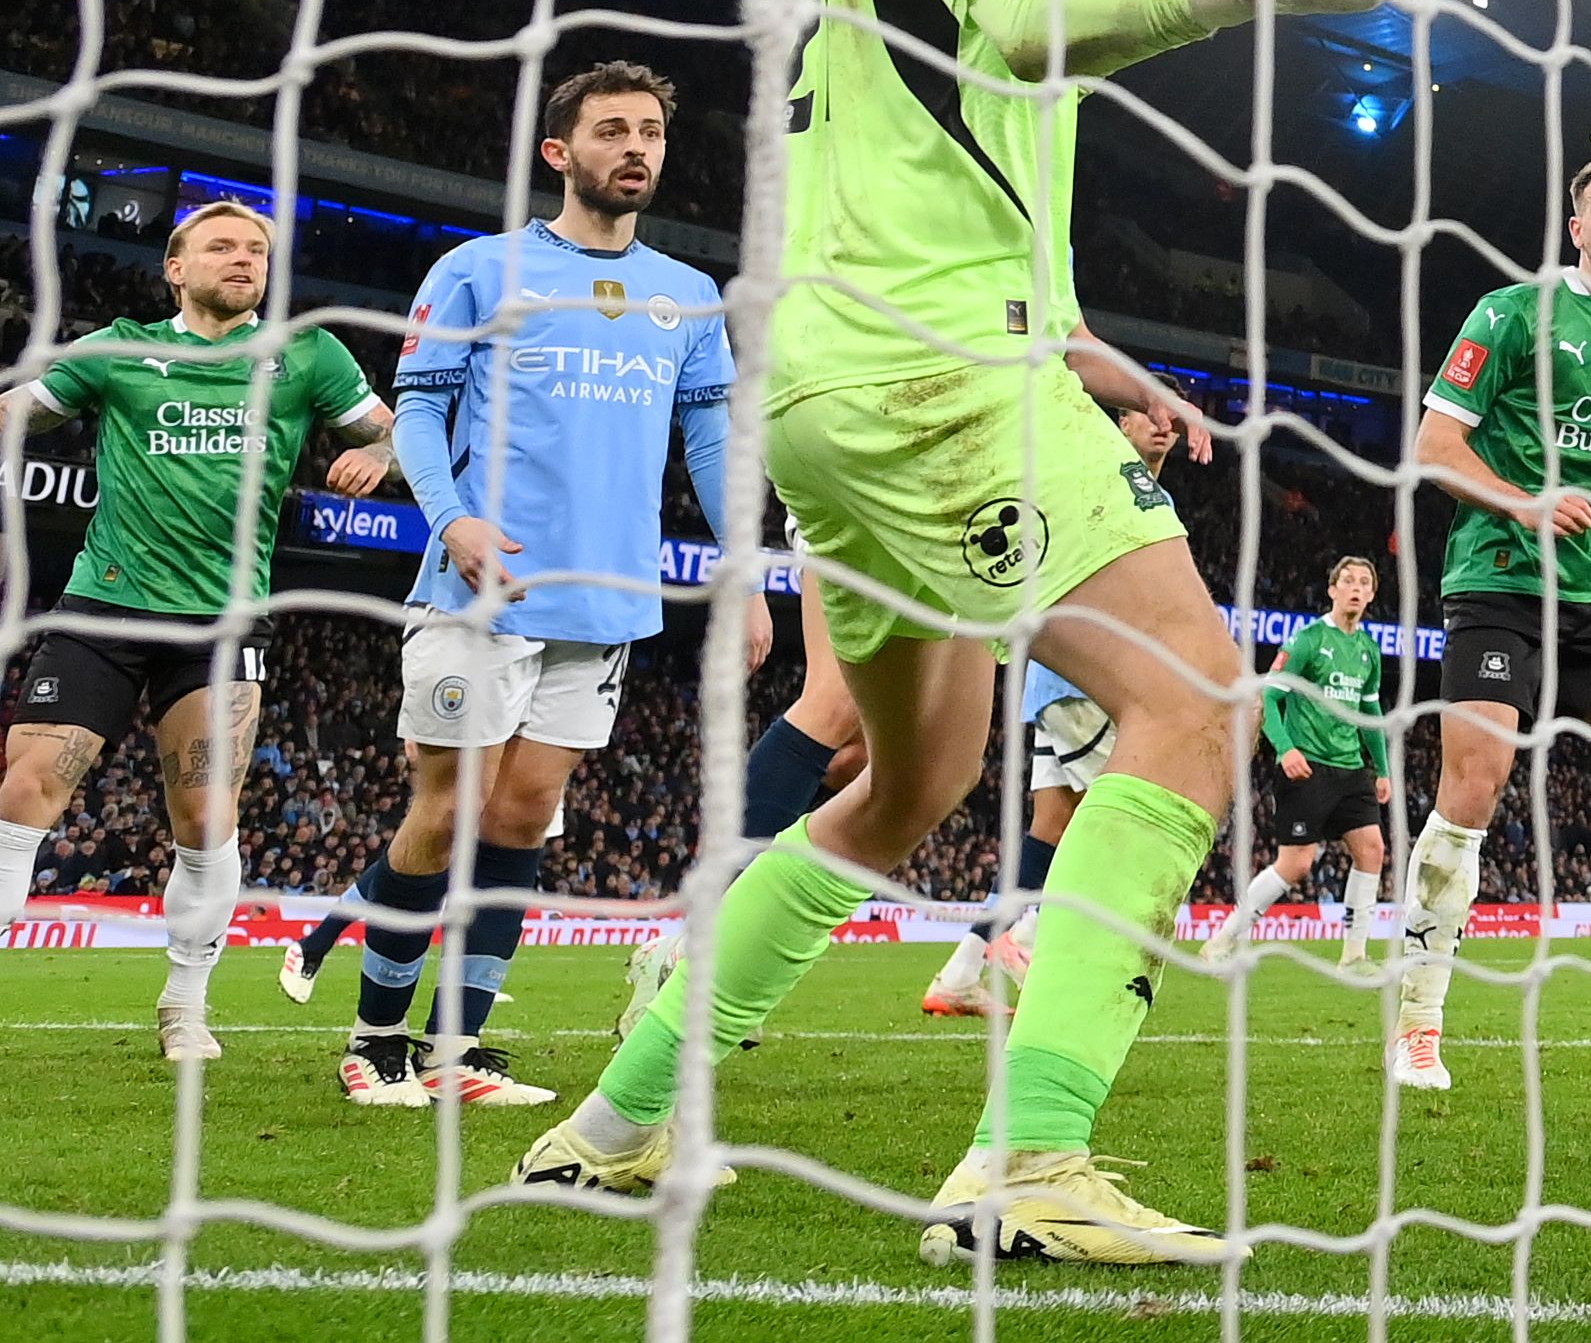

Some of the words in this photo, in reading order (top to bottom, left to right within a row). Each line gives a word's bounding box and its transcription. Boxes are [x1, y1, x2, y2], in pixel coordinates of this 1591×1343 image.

[510, 346, 676, 385] ETIHAD
[551, 381, 653, 406] AIRWAYS
[157, 401, 263, 427] Classic
[146, 431, 267, 456] Builders
[313, 501, 398, 543] xylem
